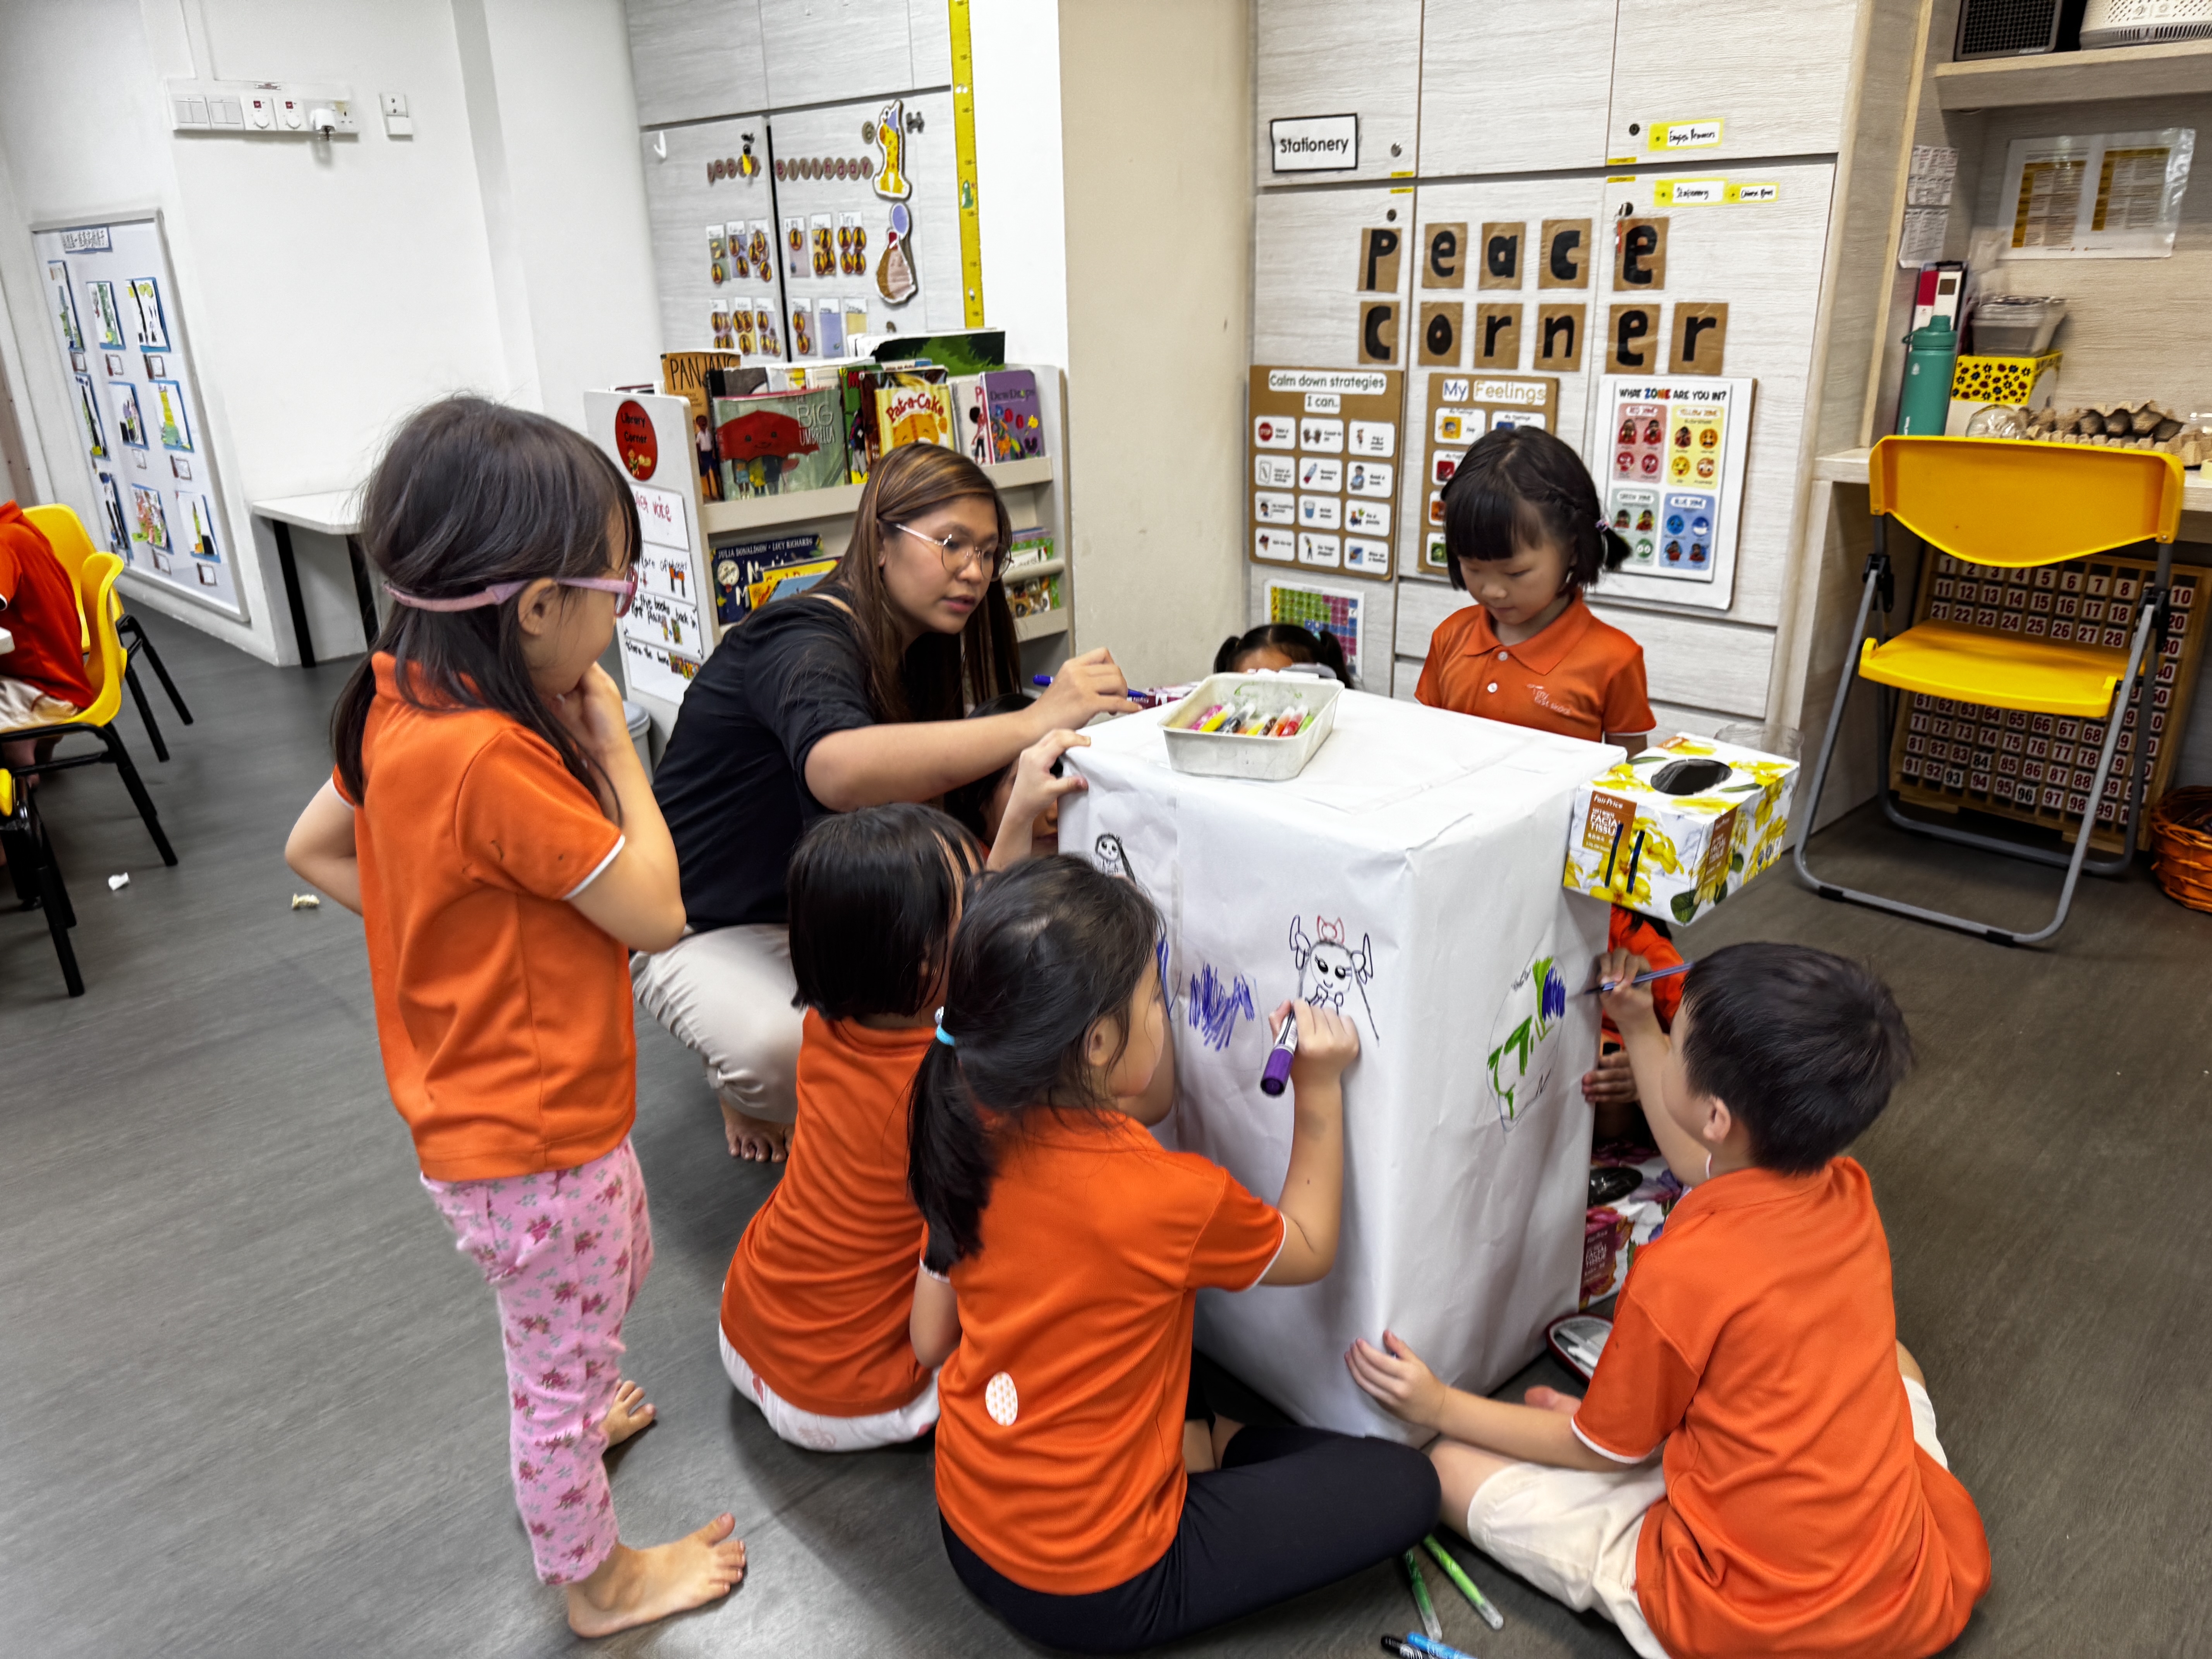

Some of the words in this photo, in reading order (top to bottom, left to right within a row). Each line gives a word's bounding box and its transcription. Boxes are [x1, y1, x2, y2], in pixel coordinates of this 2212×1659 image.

[1280, 137, 1349, 154] Stationery
[1270, 374, 1296, 386] Calm
[1298, 375, 1327, 387] down
[1330, 376, 1384, 391] strategies
[1444, 381, 1467, 400] My
[1475, 381, 1546, 405] Feelings
[1645, 387, 1671, 400] ZONE
[1673, 390, 1690, 400] ARE
[1692, 391, 1710, 401] YOU
[886, 393, 945, 424] Pat-a-Cake
[1307, 396, 1312, 407] I
[621, 412, 646, 428] Library
[797, 401, 833, 428] BIG
[624, 431, 647, 444] Corner
[718, 548, 735, 560] JULIA
[736, 543, 767, 556] DONALDSON
[772, 539, 785, 551] LUCY
[786, 537, 813, 549] RICHARDS
[1945, 558, 1952, 571] 1
[1966, 562, 1975, 576] 2
[1991, 566, 2000, 578] 3
[2015, 568, 2025, 581] 4
[2041, 572, 2050, 585] 5
[2067, 575, 2076, 589] 6
[2095, 579, 2103, 592] 7
[2120, 582, 2130, 596] 8
[2173, 589, 2191, 605] 10
[1937, 581, 1951, 595] 11
[1960, 585, 1974, 599] 12
[1984, 588, 1997, 602] 13
[2008, 592, 2023, 606] 14
[2033, 594, 2048, 609] 15
[2059, 599, 2075, 614] 16
[2085, 603, 2101, 617] 17
[2112, 606, 2128, 621] 18
[1932, 605, 1946, 618] 21
[1955, 609, 1970, 623] 22
[1977, 612, 1994, 626] 23
[2002, 615, 2018, 629] 24
[2027, 620, 2044, 633] 25
[2052, 623, 2070, 637] 26
[2078, 627, 2096, 642] 27
[2105, 631, 2123, 646] 28
[1916, 694, 1930, 707] 61
[1938, 698, 1953, 712] 62
[1960, 702, 1976, 716] 63
[1984, 708, 2000, 721] 64
[2009, 712, 2025, 726] 65
[2033, 717, 2050, 731] 66
[2059, 721, 2075, 736] 67
[2084, 727, 2101, 742] 68
[1913, 716, 1927, 729] 71
[1936, 720, 1949, 734] 72
[1957, 724, 1972, 738] 73
[1980, 729, 1996, 743] 74
[2006, 735, 2021, 749] 75
[2030, 740, 2045, 754] 76
[2055, 745, 2071, 759] 77
[2080, 750, 2096, 766] 78
[1908, 737, 1923, 750] 81
[1930, 742, 1945, 756] 82
[1952, 746, 1967, 761] 83
[1973, 754, 1988, 768] 84
[2001, 758, 2016, 772] 85
[2025, 763, 2040, 778] 86
[2050, 769, 2066, 783] 87
[2075, 773, 2090, 788] 88
[1905, 758, 1919, 772] 91
[1927, 763, 1941, 777] 92
[1972, 774, 1987, 788] 94
[1997, 779, 2011, 793] 95
[2018, 787, 2032, 801] 96
[2045, 791, 2061, 805] 97
[2070, 796, 2085, 811] 98
[1594, 794, 1623, 809] FairPrice
[1591, 821, 1616, 837] TISSU
